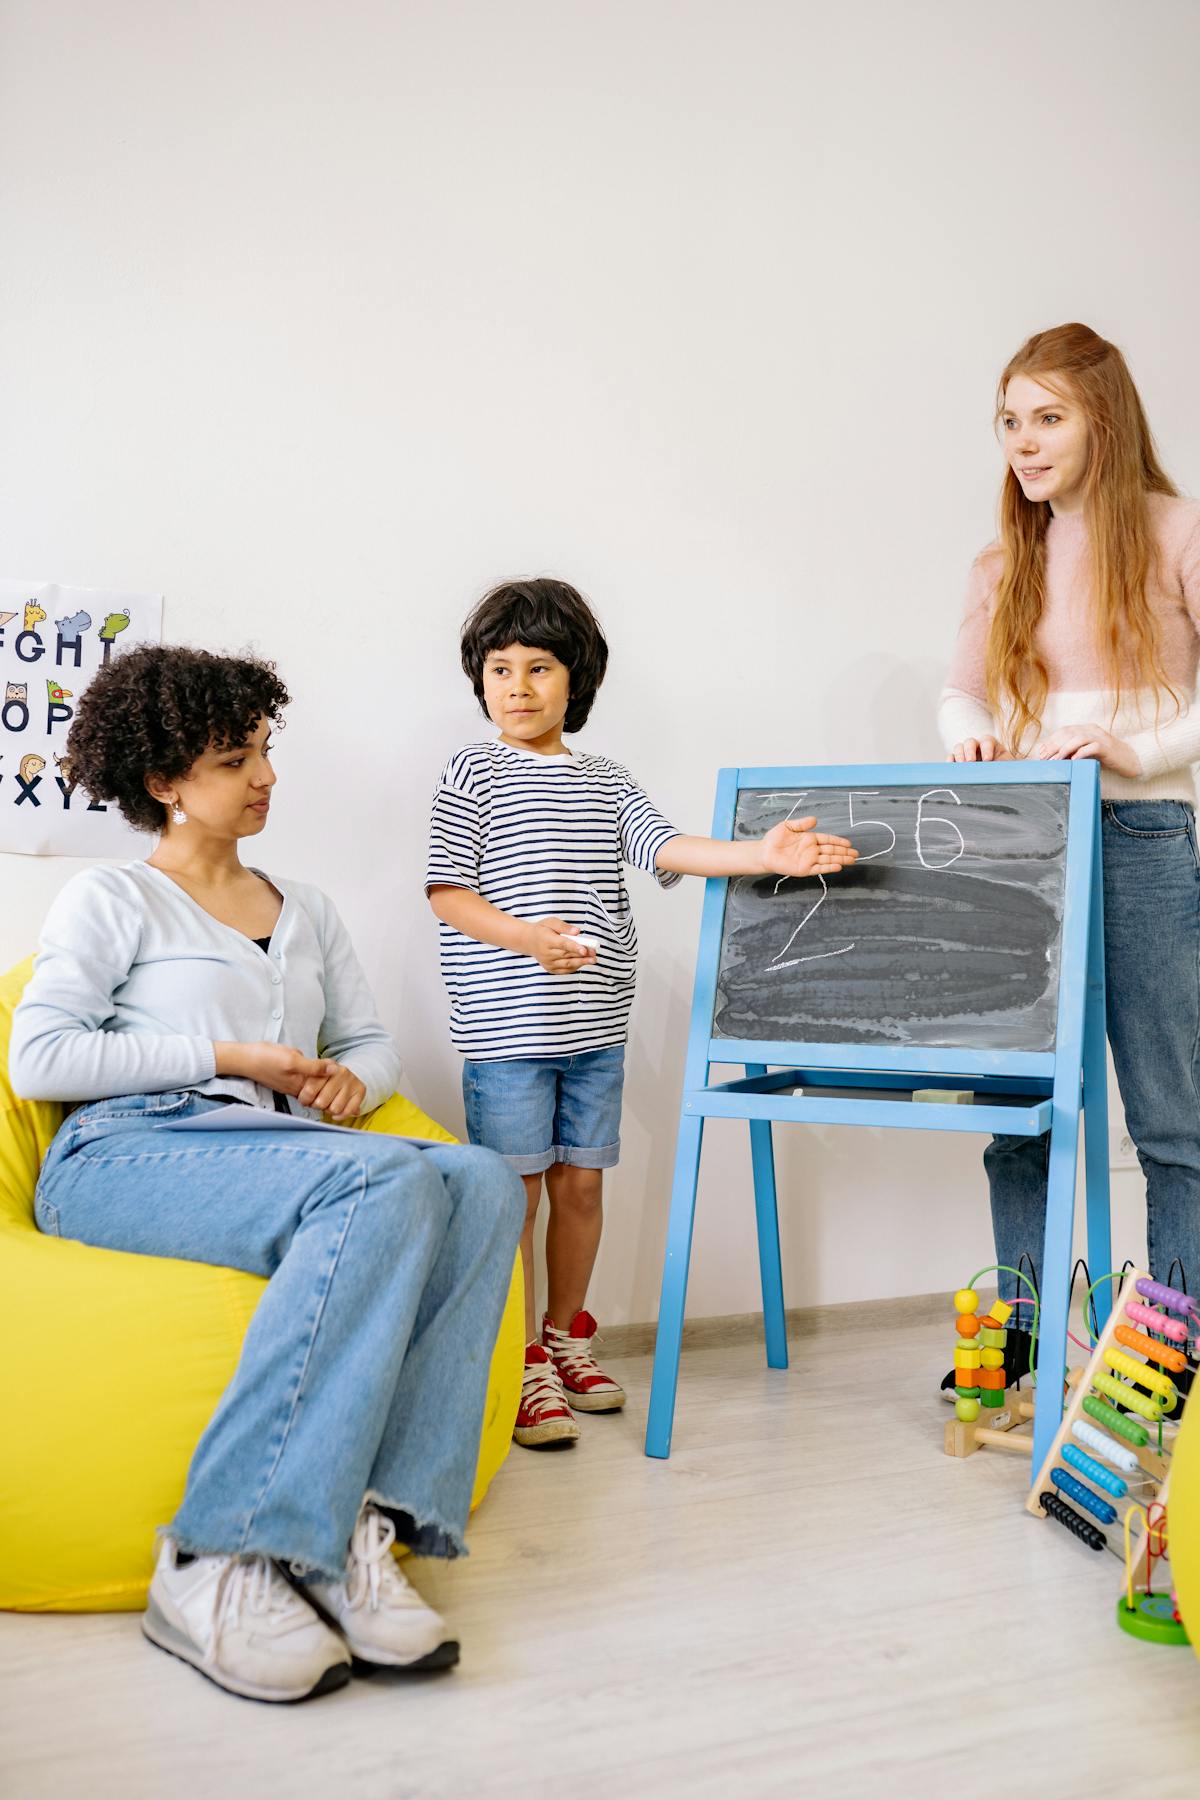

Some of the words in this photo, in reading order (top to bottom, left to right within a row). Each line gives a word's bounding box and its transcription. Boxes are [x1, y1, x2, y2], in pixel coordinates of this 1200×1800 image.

[15, 630, 46, 663] G
[56, 633, 82, 667] H
[2, 699, 29, 732] O
[47, 703, 73, 735] P
[14, 773, 43, 807] X
[55, 776, 79, 810] Y
[849, 790, 896, 862] 5
[914, 788, 964, 869] 6
[763, 873, 855, 972] 2
